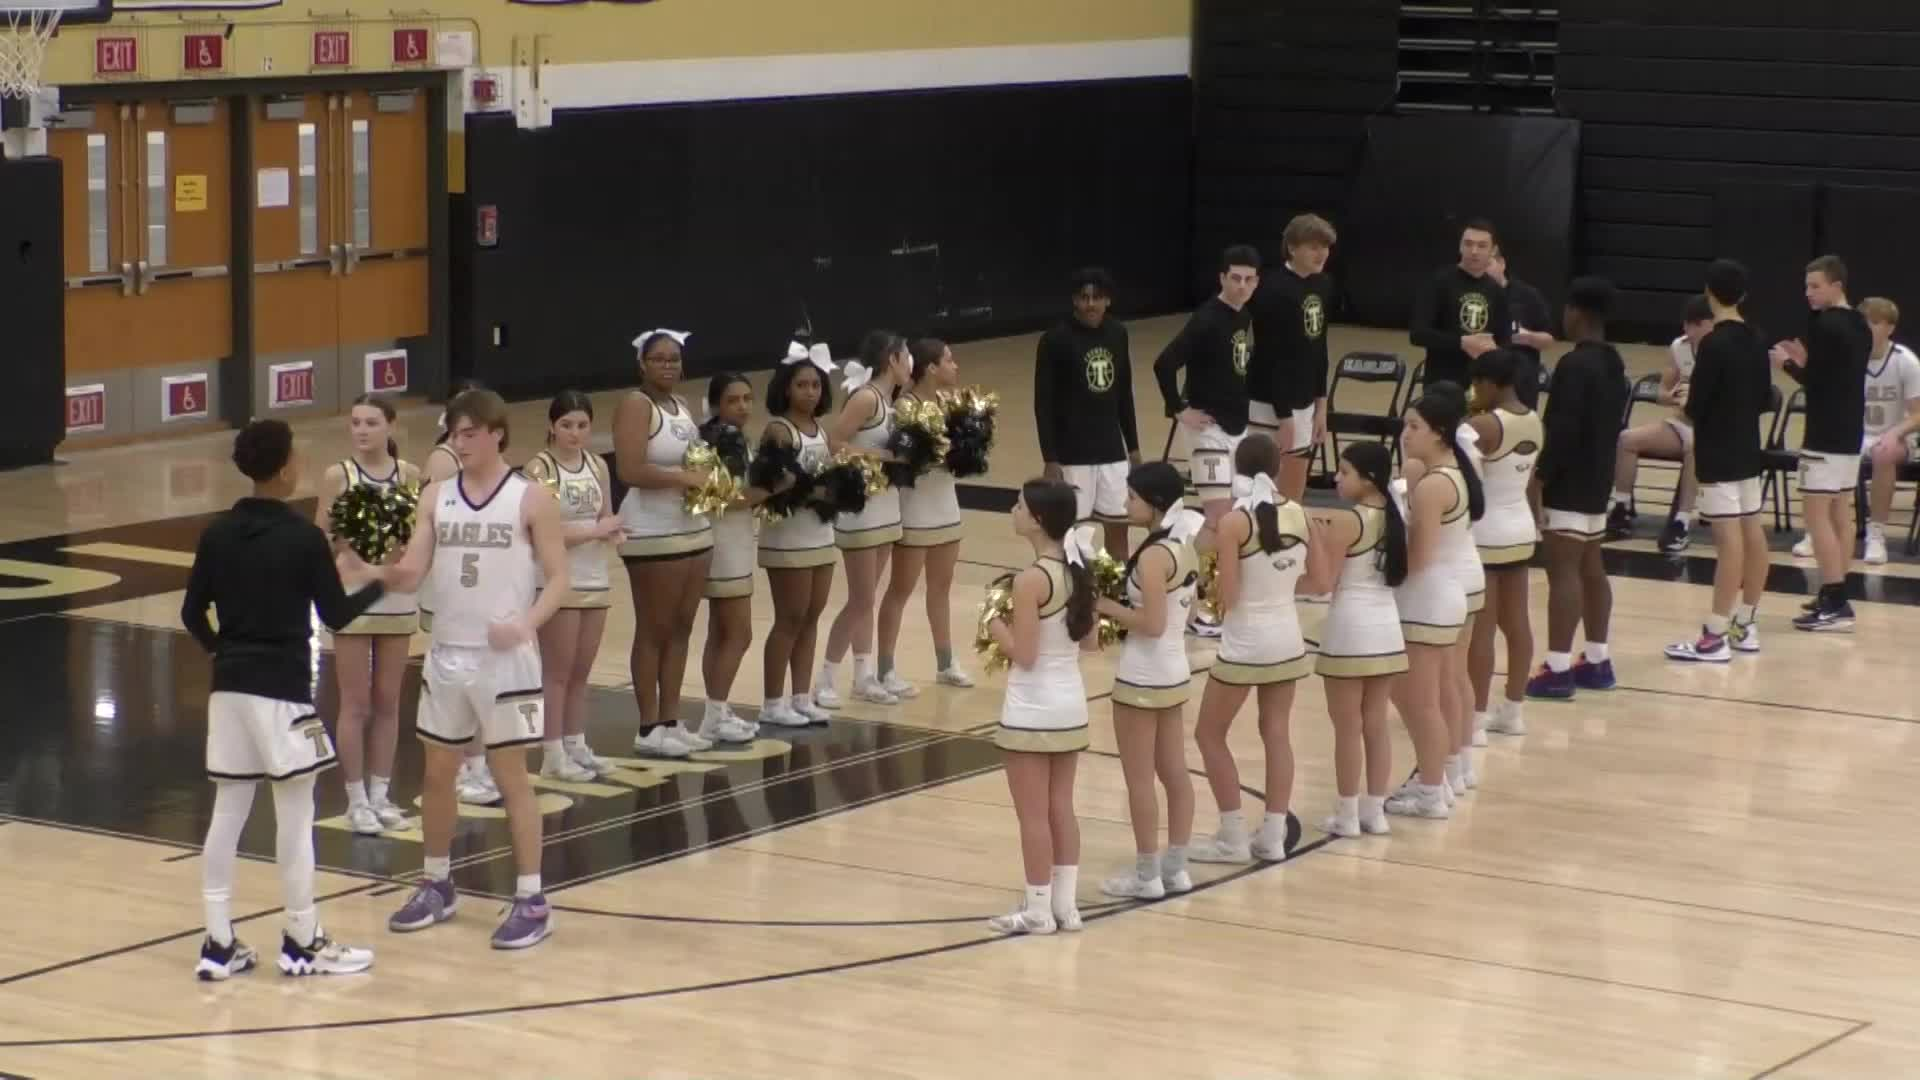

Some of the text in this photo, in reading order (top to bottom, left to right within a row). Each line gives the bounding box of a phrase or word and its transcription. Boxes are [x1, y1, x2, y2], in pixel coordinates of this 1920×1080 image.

[103, 40, 133, 71] EXIT
[318, 35, 347, 62] EXIT
[281, 372, 308, 400] EXIT
[69, 396, 98, 427] EXIT
[437, 521, 513, 549] EAGLES
[460, 553, 480, 588] 5
[516, 703, 540, 734] T
[303, 726, 330, 758] T
